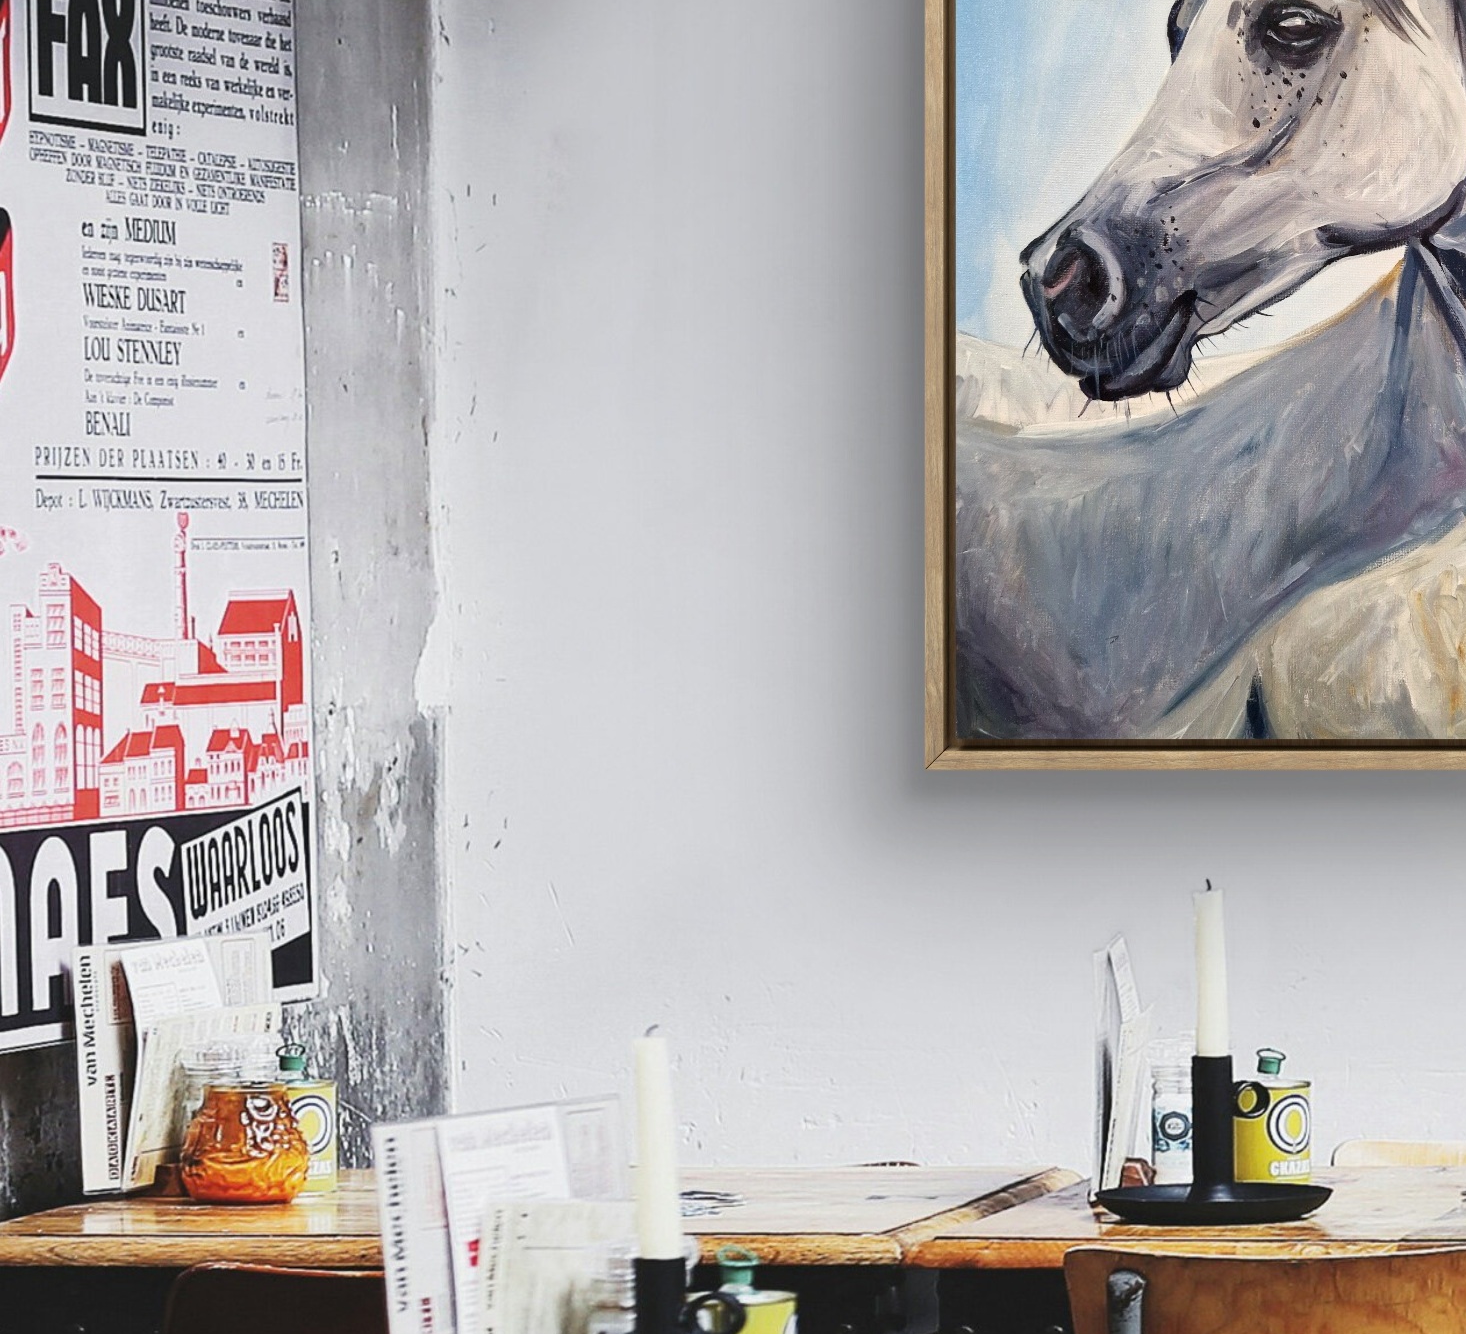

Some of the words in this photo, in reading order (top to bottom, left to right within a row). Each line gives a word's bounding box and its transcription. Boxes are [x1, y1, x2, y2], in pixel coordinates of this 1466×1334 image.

[176, 15, 188, 36] De
[220, 54, 235, 68] van
[205, 77, 220, 91] van
[81, 221, 94, 238] en
[125, 216, 176, 245] MEDIUM
[82, 283, 131, 310] WIESKE
[137, 287, 186, 314] DUSART
[84, 336, 111, 361] LOU
[85, 411, 131, 437] BENALI
[35, 446, 91, 470] PRIJZEN
[99, 448, 124, 468] DER
[133, 449, 199, 470] PLAATSEN
[186, 800, 299, 920] WAARLOOS
[79, 955, 97, 1048] Mechelen
[86, 1050, 97, 1087] van
